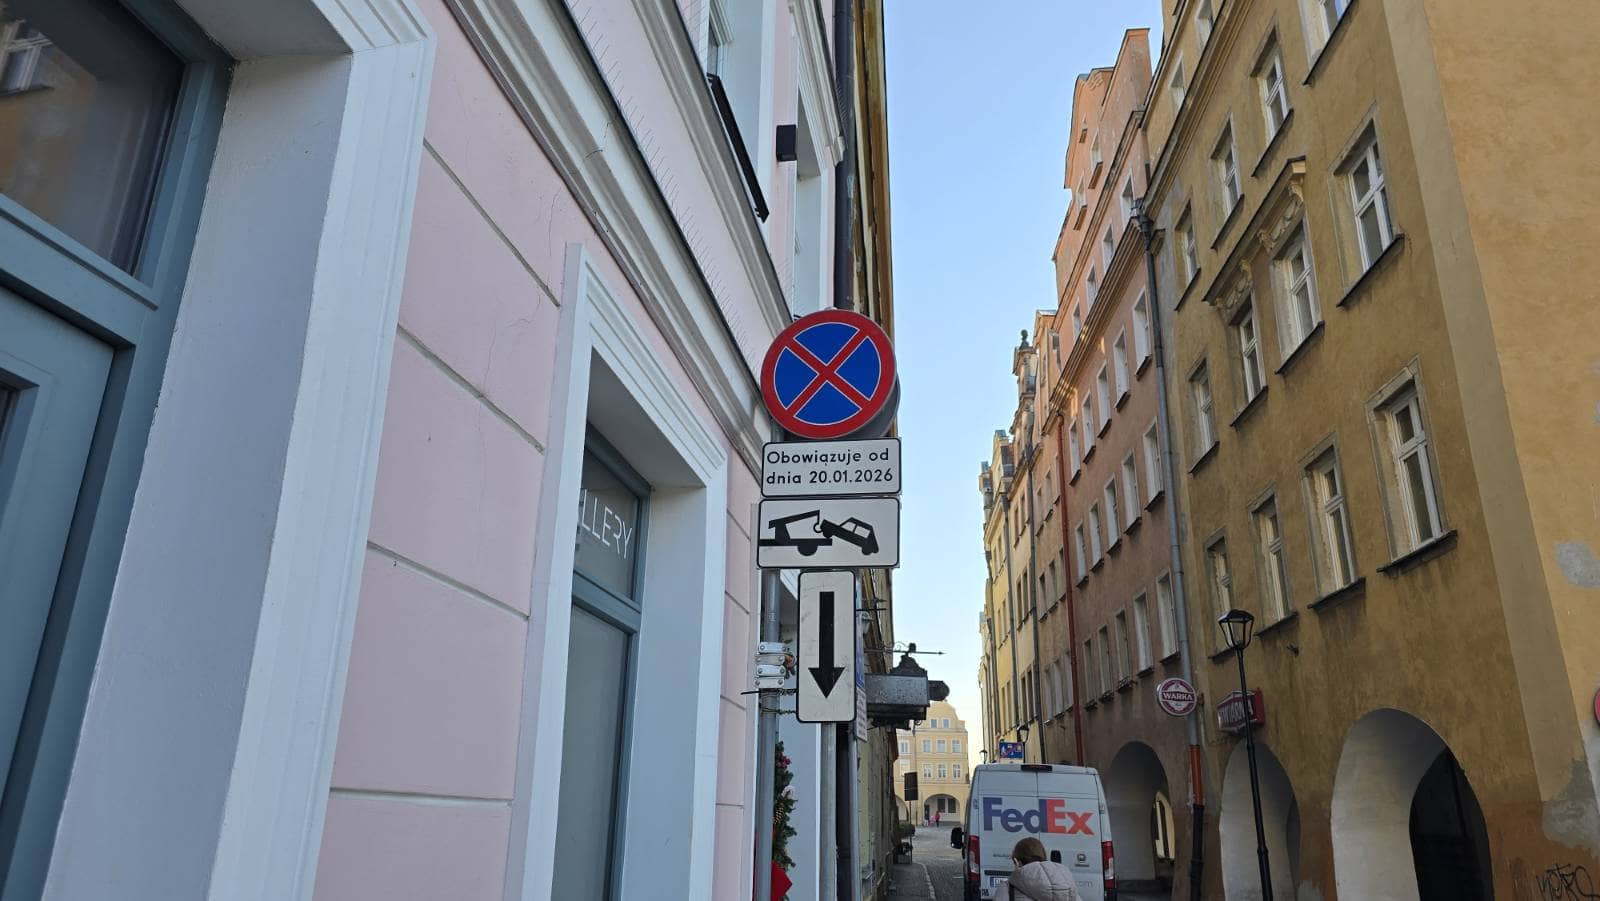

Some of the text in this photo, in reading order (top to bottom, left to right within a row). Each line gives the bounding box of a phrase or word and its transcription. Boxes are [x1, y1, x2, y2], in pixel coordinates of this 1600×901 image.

[766, 448, 889, 467] Obowiązuje od
[766, 468, 893, 485] dnia 20.01.2026
[581, 488, 633, 560] LLERY
[1162, 692, 1193, 701] WARKA
[982, 796, 1096, 836] FedEx
